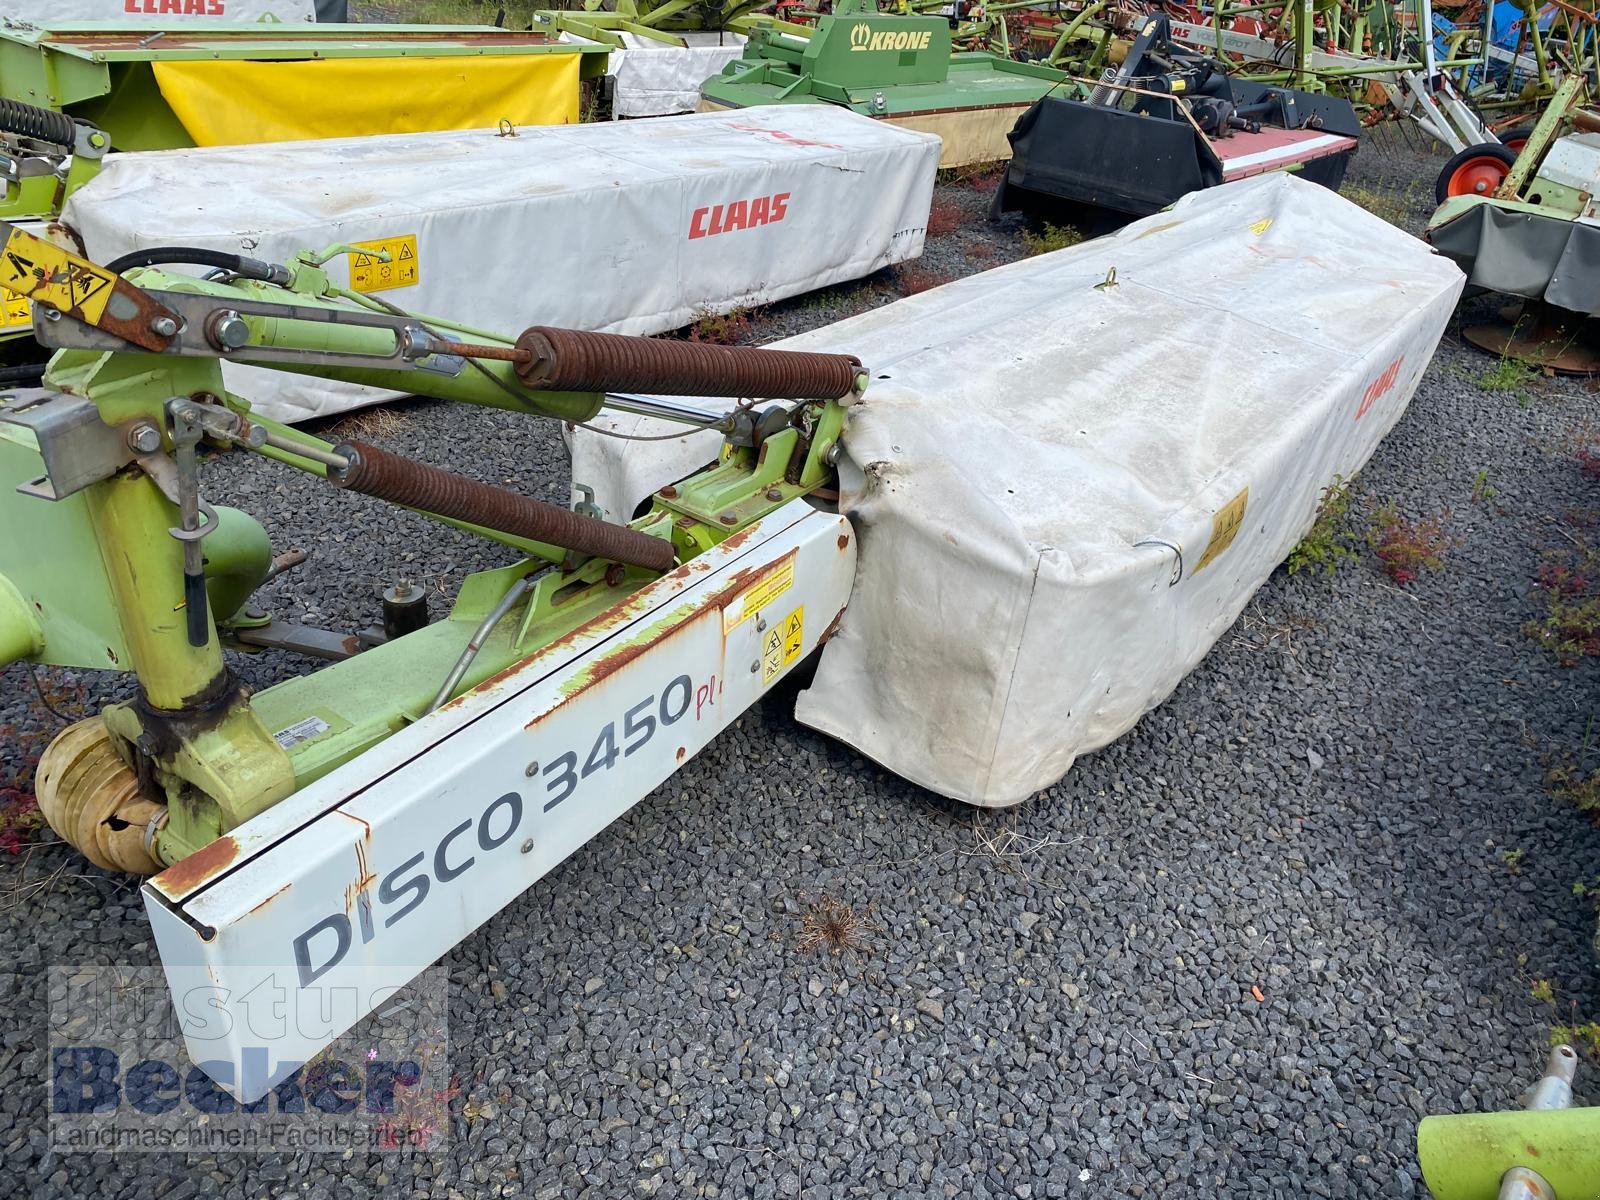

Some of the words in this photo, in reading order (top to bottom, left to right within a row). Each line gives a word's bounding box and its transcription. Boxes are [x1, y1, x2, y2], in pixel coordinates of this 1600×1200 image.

[124, 0, 225, 15] CLAAS
[869, 31, 932, 51] KRONE
[688, 192, 791, 240] CLAAS
[293, 791, 523, 989] DISCO
[543, 674, 692, 813] 3450
